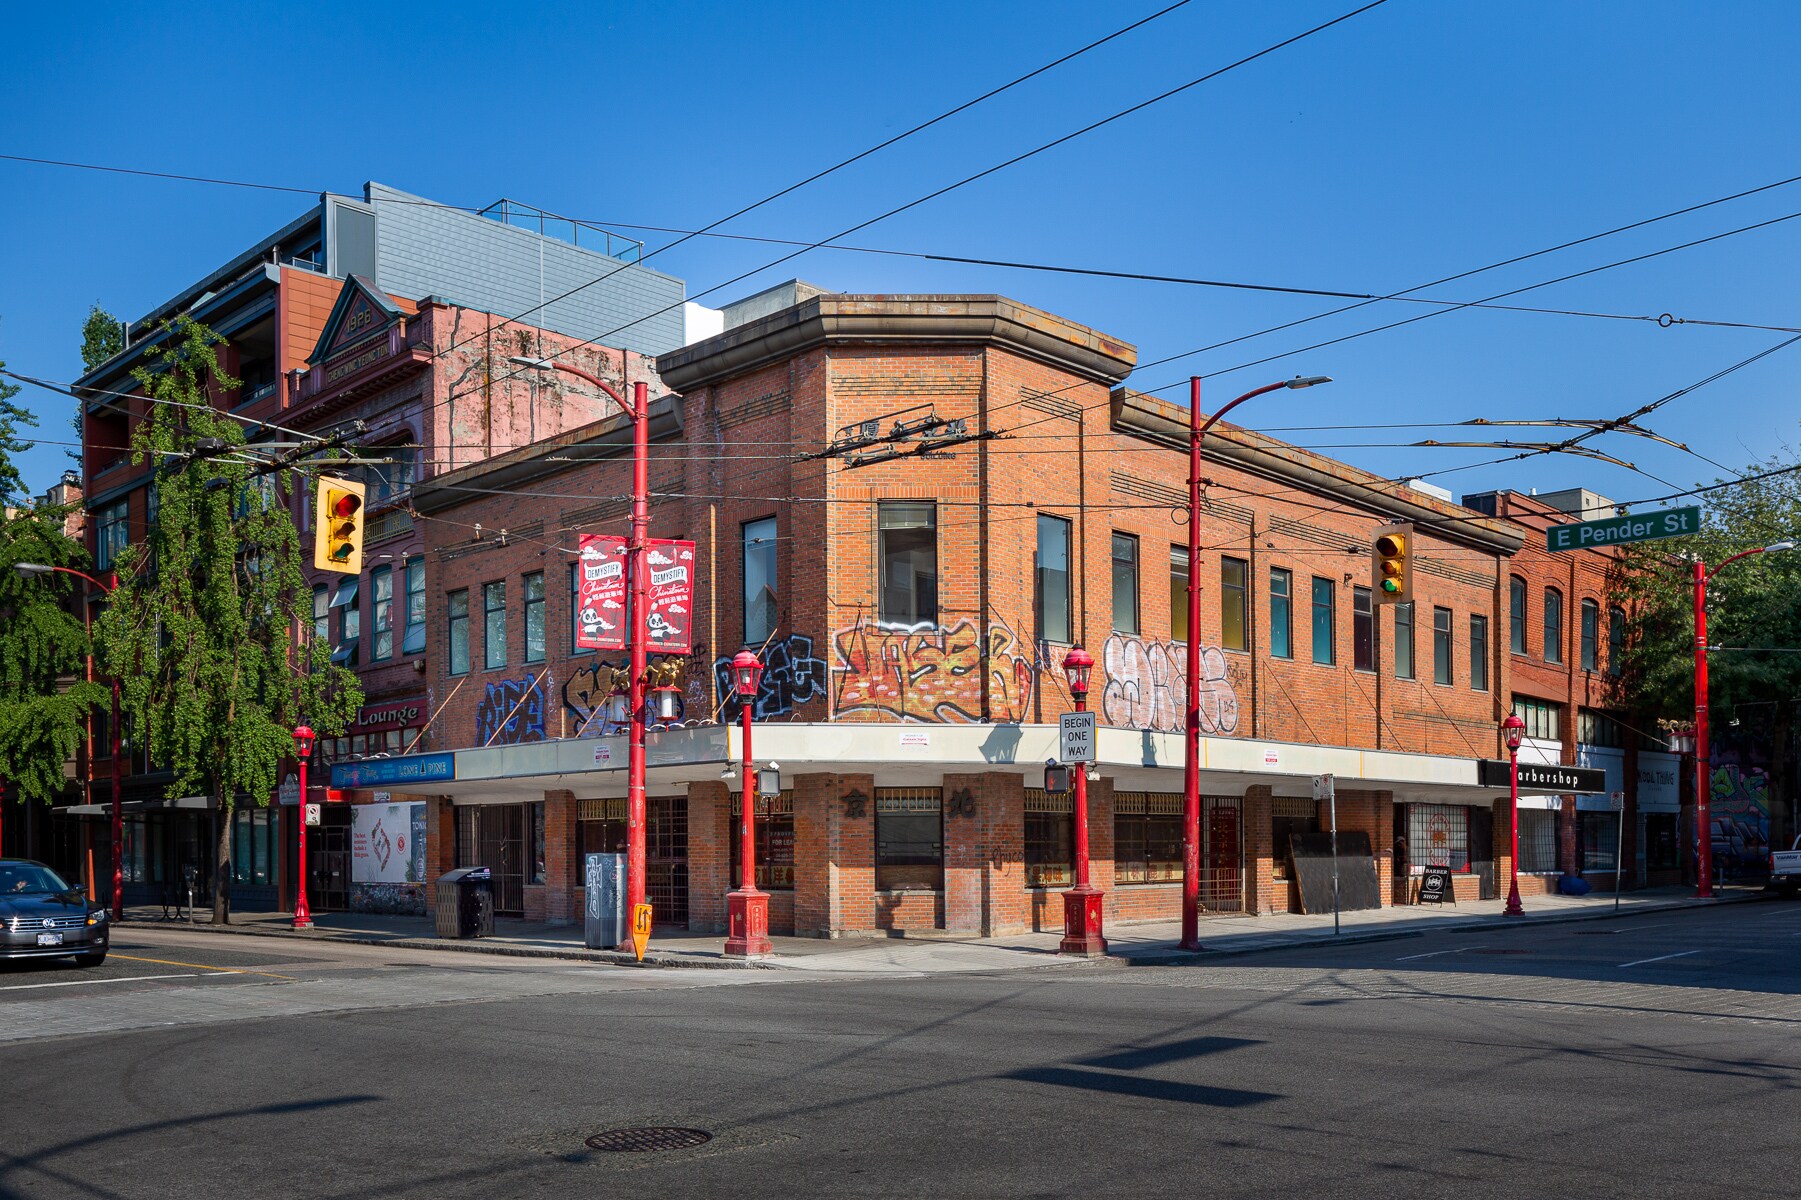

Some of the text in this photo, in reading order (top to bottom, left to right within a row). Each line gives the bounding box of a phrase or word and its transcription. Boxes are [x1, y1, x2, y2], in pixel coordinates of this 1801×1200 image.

[347, 308, 371, 333] 1926
[377, 343, 389, 358] TON
[1557, 513, 1688, 547] E Pender St
[587, 563, 620, 579] DEMYSTIFY
[653, 568, 685, 584] DEMYSTIFY
[582, 579, 625, 596] Chinatown
[648, 584, 690, 600] Chinatown
[358, 706, 418, 727] Lounge
[1064, 717, 1091, 728] BEGIN
[1068, 731, 1088, 742] ONE
[1068, 746, 1088, 756] WAY
[399, 764, 418, 777] LONE
[428, 762, 446, 774] PINE
[1518, 768, 1578, 788] arbershop
[841, 788, 869, 819] 京
[948, 787, 976, 819] 北
